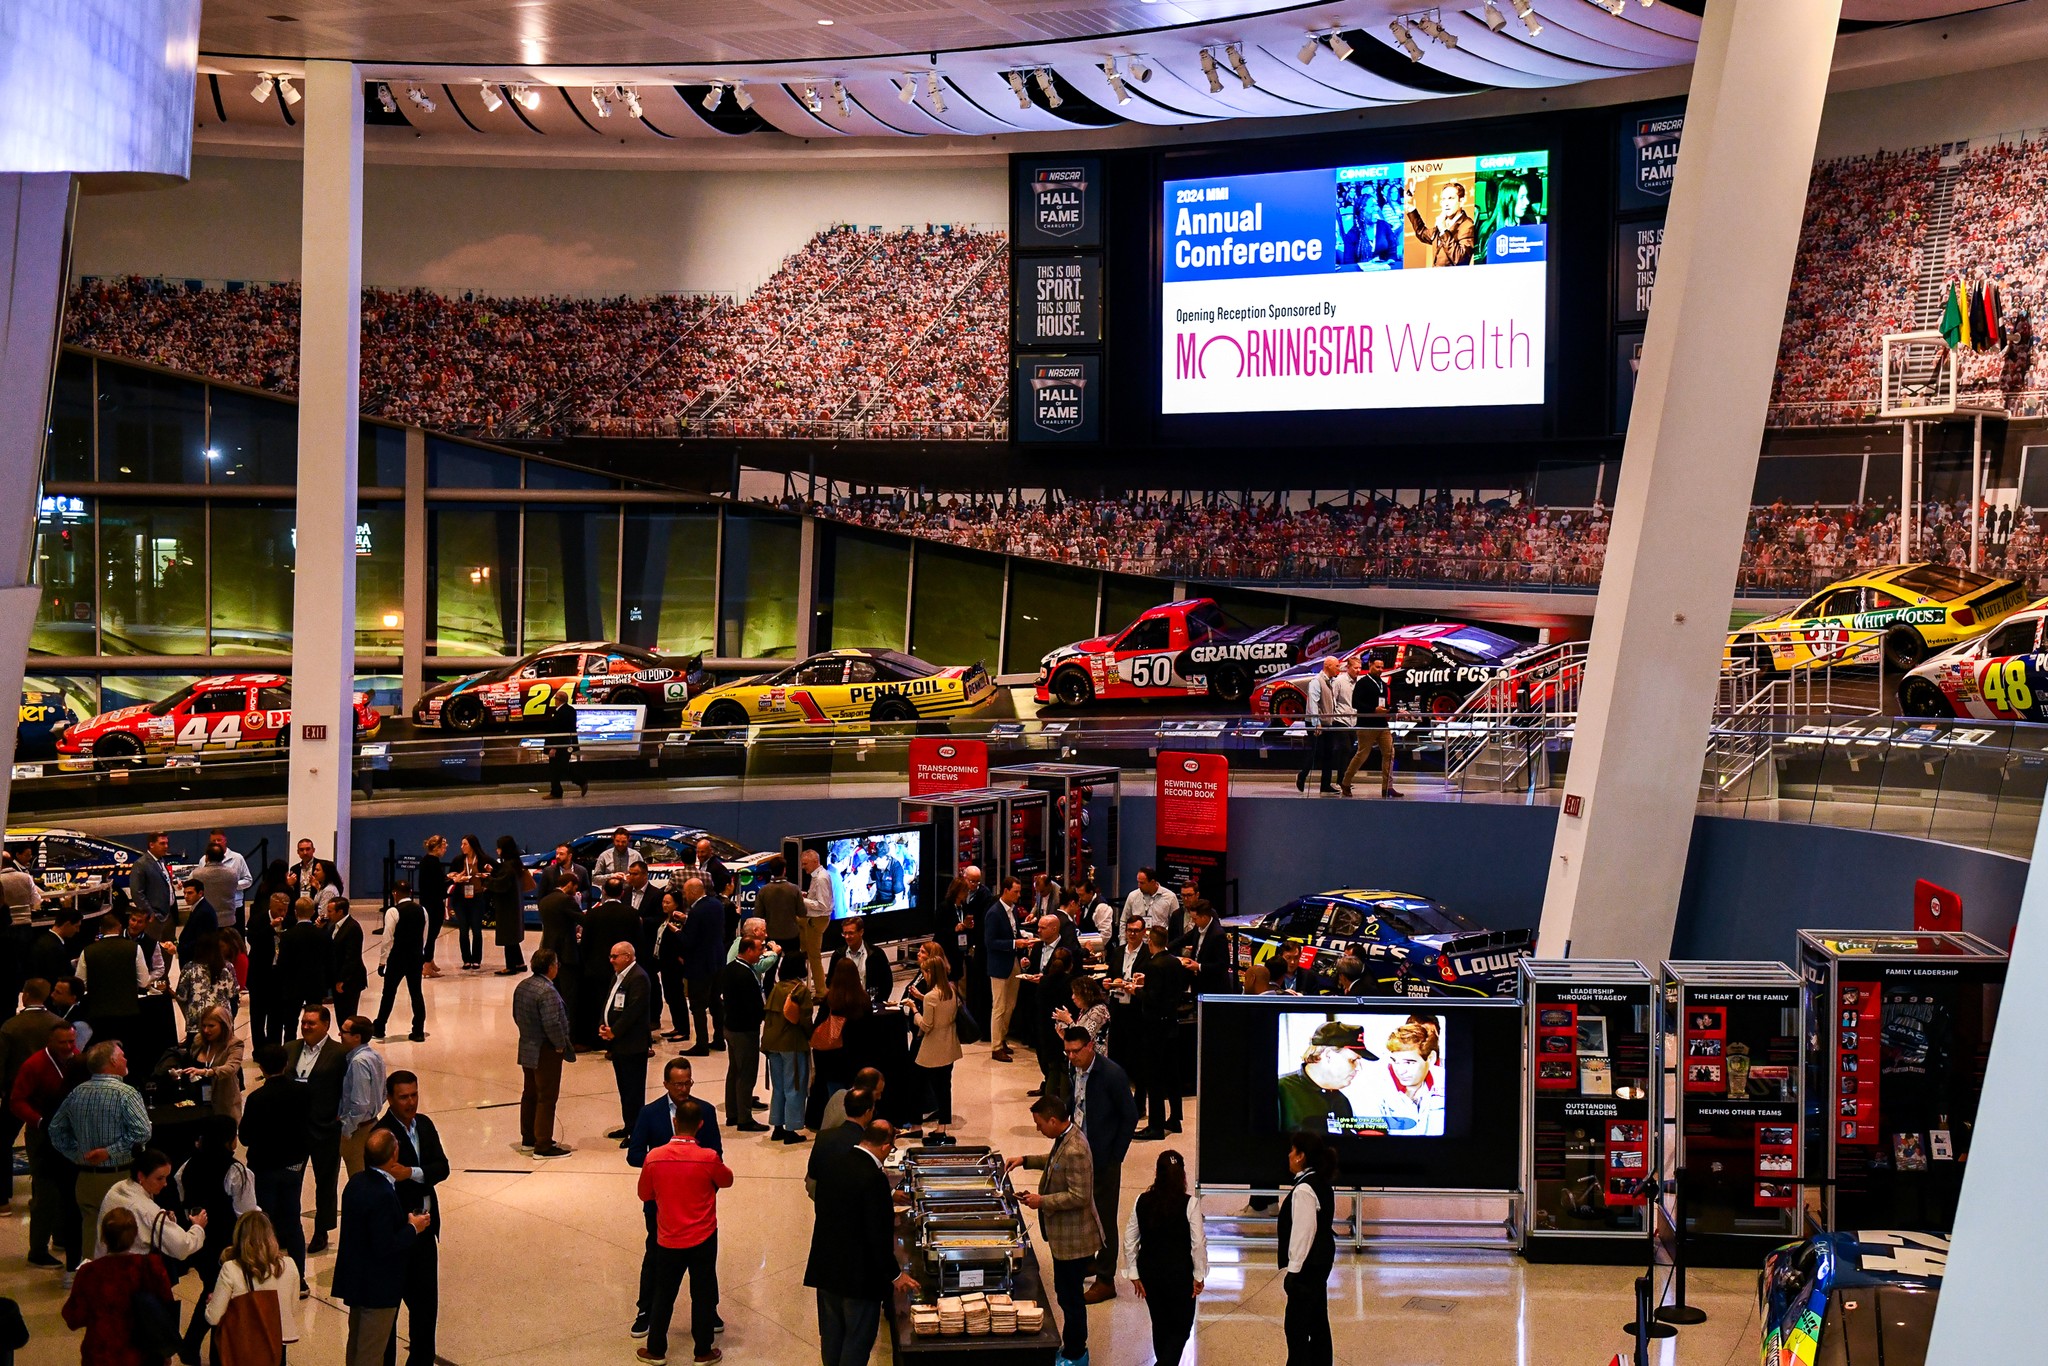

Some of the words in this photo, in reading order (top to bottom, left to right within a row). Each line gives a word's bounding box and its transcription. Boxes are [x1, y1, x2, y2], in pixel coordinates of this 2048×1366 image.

[1651, 119, 1683, 133] NASCAR
[1641, 144, 1678, 160] HALL
[1480, 156, 1517, 169] GROW
[1049, 171, 1081, 180] NASCAR
[1340, 167, 1389, 180] CONNECT
[1040, 192, 1079, 205] HALL
[1176, 189, 1204, 204] 2024
[1040, 210, 1079, 222] FAME
[1175, 202, 1262, 236] Annual
[1638, 230, 1654, 244] THIS
[1175, 237, 1322, 268] Conference
[1037, 266, 1054, 278] THIS
[1056, 266, 1063, 278] IS
[1065, 265, 1081, 277] OUR
[1637, 271, 1653, 286] THIS
[1037, 279, 1084, 300] SPORT.
[1037, 302, 1054, 314] THIS
[1056, 302, 1063, 313] IS
[1065, 302, 1081, 313] OUR
[1176, 308, 1215, 324] Opening
[1218, 306, 1266, 321] Reception
[1269, 302, 1321, 320] Sponsored
[1324, 301, 1336, 317] By
[1037, 315, 1084, 337] HOUSE.
[1177, 325, 1373, 380] MORNINGSTAR
[1385, 319, 1530, 373] Wealth
[1048, 369, 1080, 377] NASCAR
[1040, 389, 1078, 401] HALL
[1040, 407, 1078, 418] FAME
[357, 523, 371, 534] PA
[356, 535, 371, 548] HA
[1975, 602, 2003, 622] WHITE
[2003, 593, 2024, 613] HOUSE
[1853, 612, 1894, 630] WHITE
[1896, 607, 1944, 624] HOUSE
[1809, 622, 1841, 658] 37
[1926, 636, 1958, 645] Hydrotex
[1191, 643, 1287, 662] GRAINGER
[637, 670, 647, 681] DU
[648, 669, 669, 680] PONT
[1133, 658, 1170, 687] 50
[1254, 662, 1291, 674] .com
[589, 673, 632, 681] AUTOMOTIVE
[1405, 668, 1451, 687] Sprint
[1456, 667, 1490, 682] PCS
[667, 683, 684, 697] Q
[850, 680, 942, 703] PENNZOIL
[1983, 660, 2032, 711] 48
[250, 687, 258, 711] OLDS
[523, 683, 575, 716] 24
[19, 706, 48, 722] er
[788, 690, 833, 725] 1
[177, 715, 242, 751] 44
[305, 726, 324, 738] EXIT
[918, 764, 978, 773] TRANSFORMING
[1164, 780, 1202, 789] REWRITING
[1204, 782, 1217, 790] THE
[1164, 788, 1193, 796] RECORD
[1195, 790, 1214, 798] BOOK
[45, 872, 67, 884] NAPA
[1888, 1024, 1925, 1040] GMAC
